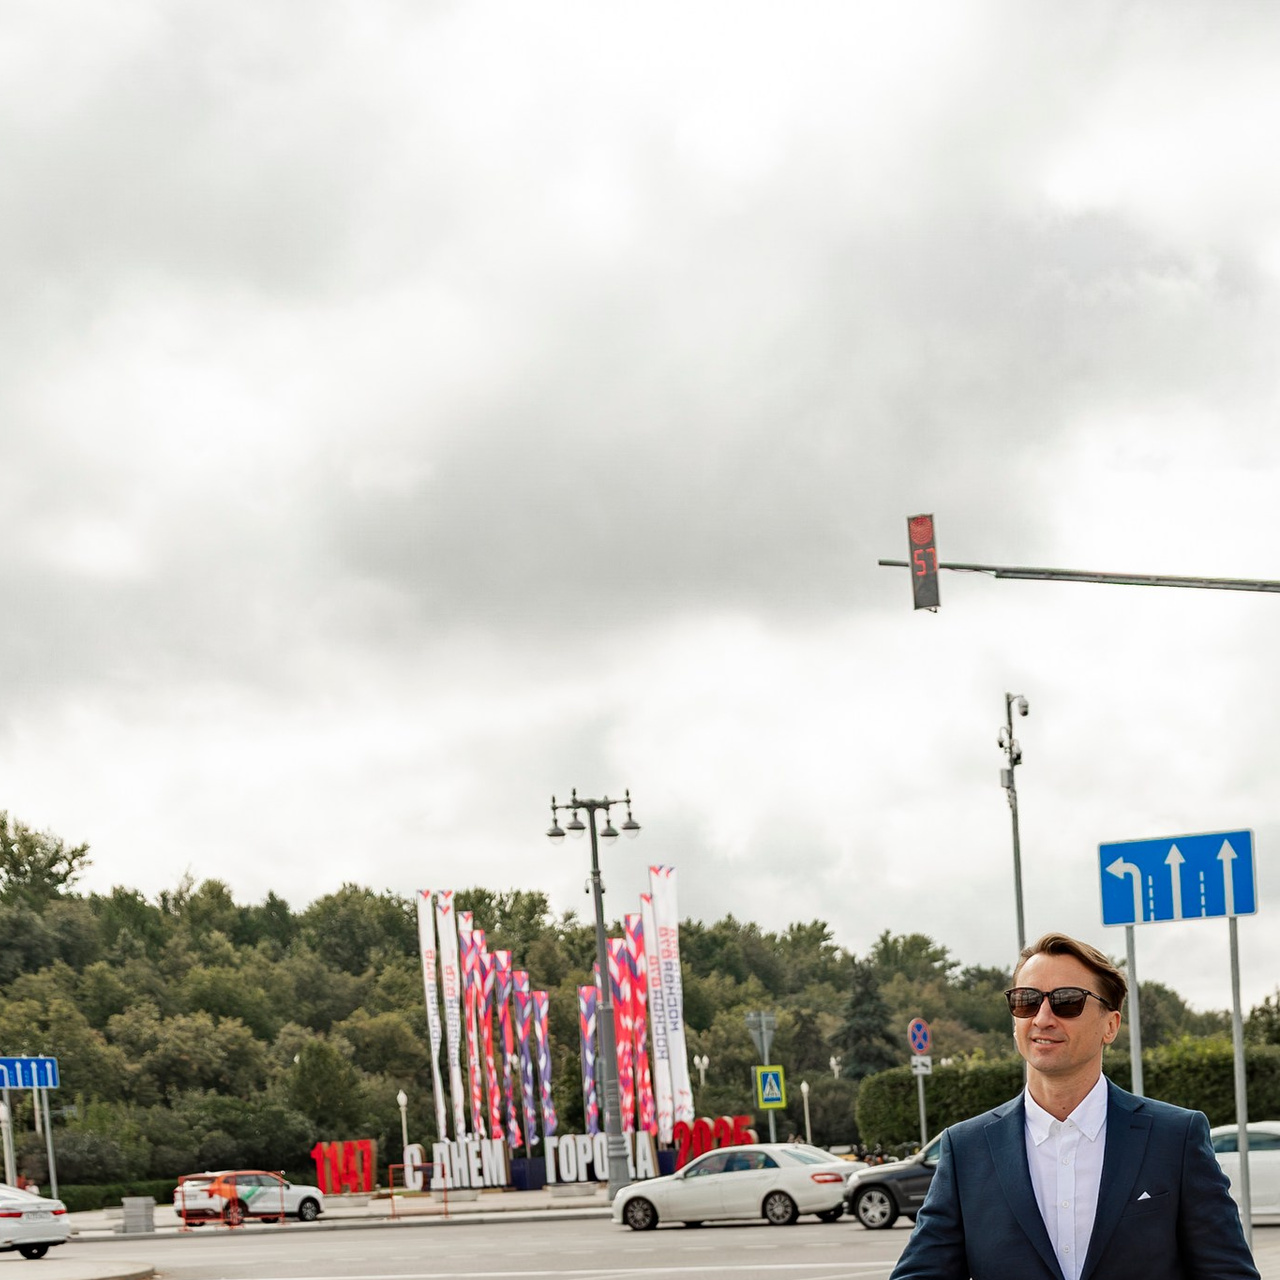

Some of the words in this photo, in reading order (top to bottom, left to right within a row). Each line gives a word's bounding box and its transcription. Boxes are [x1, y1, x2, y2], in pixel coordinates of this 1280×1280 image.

[913, 547, 937, 576] 57
[311, 1139, 373, 1194] 1147
[403, 1144, 425, 1191] С
